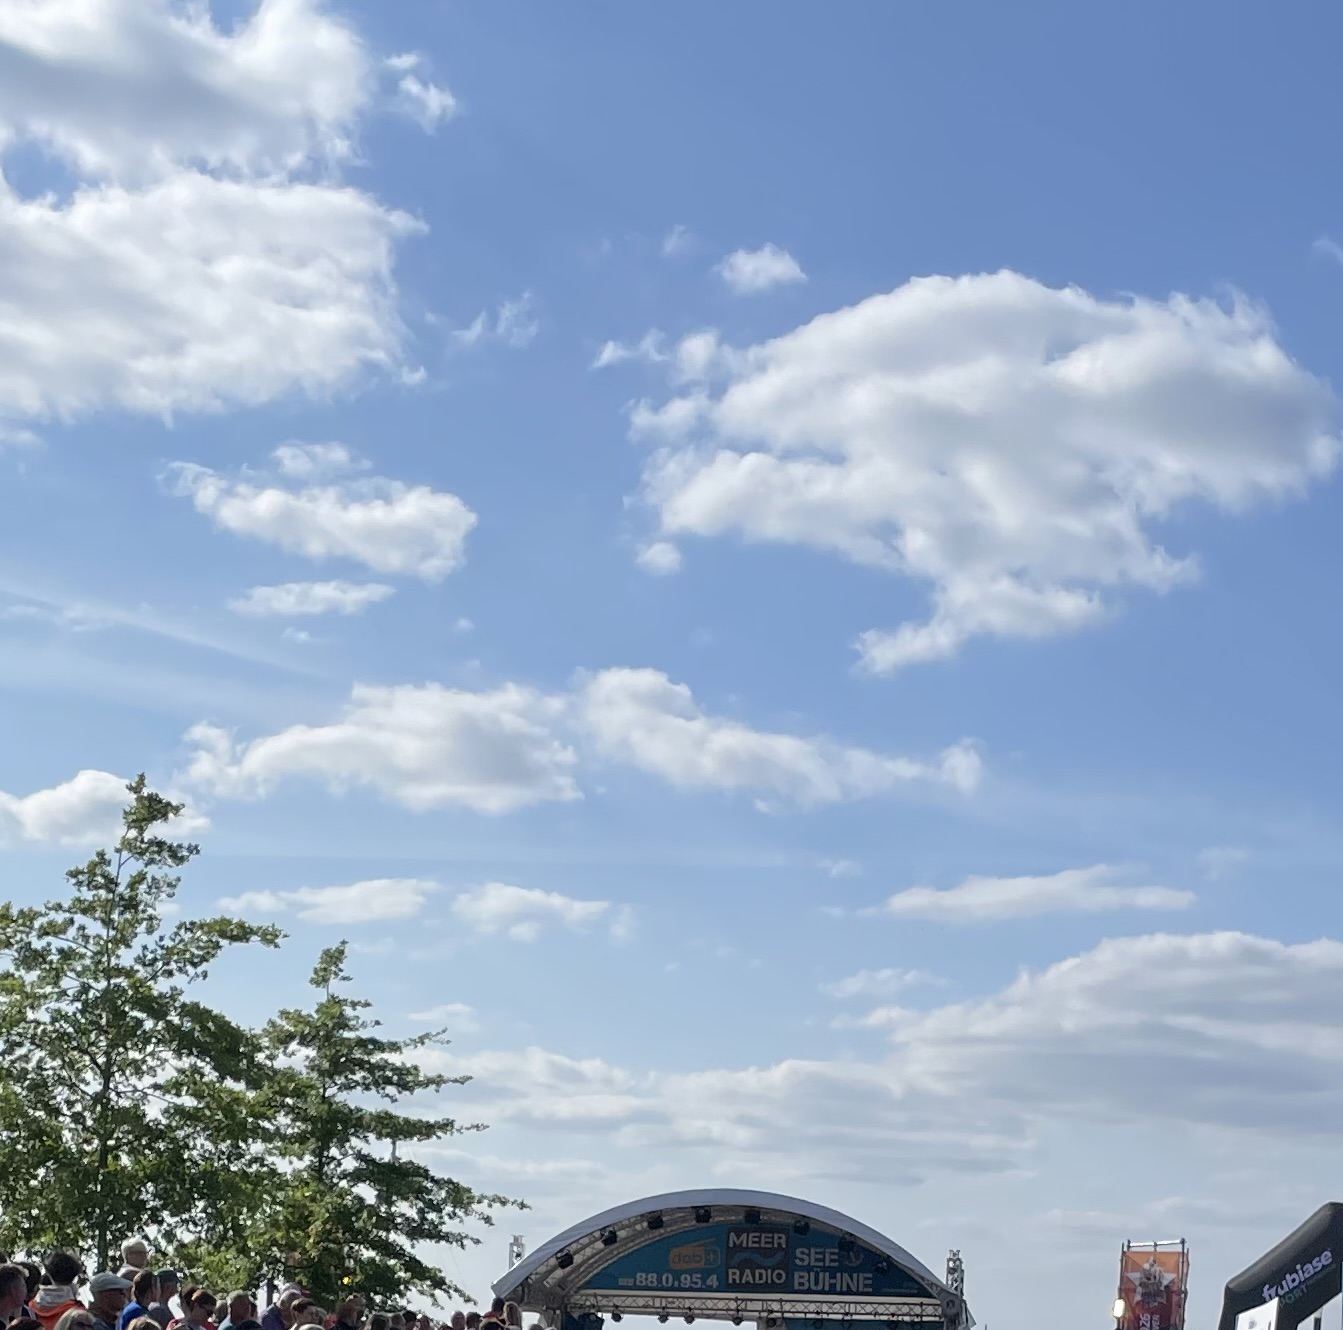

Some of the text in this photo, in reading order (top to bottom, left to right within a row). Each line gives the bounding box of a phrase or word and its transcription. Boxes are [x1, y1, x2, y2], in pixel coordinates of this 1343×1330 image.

[728, 1232, 787, 1248] MEER
[795, 1247, 840, 1267] SEE
[728, 1269, 787, 1285] RADIO
[793, 1267, 874, 1293] BÜHNE
